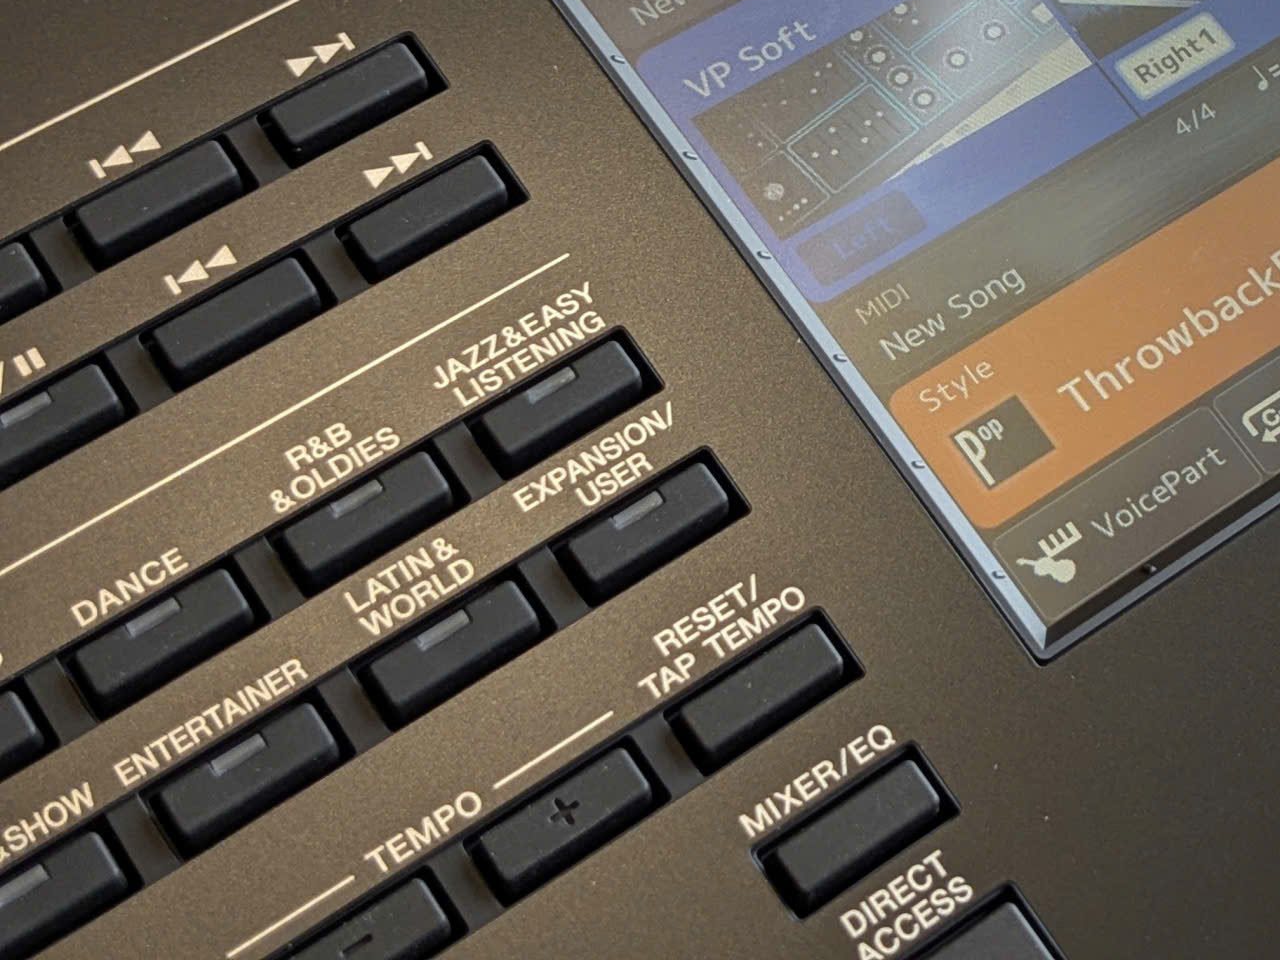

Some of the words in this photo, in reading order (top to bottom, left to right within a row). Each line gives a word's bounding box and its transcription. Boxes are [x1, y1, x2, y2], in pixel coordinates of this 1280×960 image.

[683, 61, 732, 98] VP
[738, 19, 817, 73] Soft
[1134, 25, 1218, 85] Right1
[1174, 101, 1218, 137] 4/4
[855, 283, 911, 326] MIDI
[879, 311, 948, 361] New
[948, 267, 1027, 321] Song
[454, 311, 606, 408] LISTENING
[919, 358, 995, 413] Style
[270, 427, 401, 514] &OLDIES
[286, 422, 352, 472] R&B
[513, 401, 675, 512] EXPANSION/
[575, 452, 654, 508] USER
[1090, 446, 1227, 539] VoicePart
[71, 548, 189, 628] DANCE
[359, 558, 475, 636] WORLD
[654, 574, 759, 657] RESET/
[637, 652, 696, 699] TAP
[702, 586, 806, 662] TEMPO
[113, 658, 309, 788] ENTERTAINER
[738, 724, 896, 839] MIXER/EQ
[364, 791, 483, 874] TEMPO
[840, 849, 948, 939] DIRECT
[857, 876, 974, 960] ACCESS
